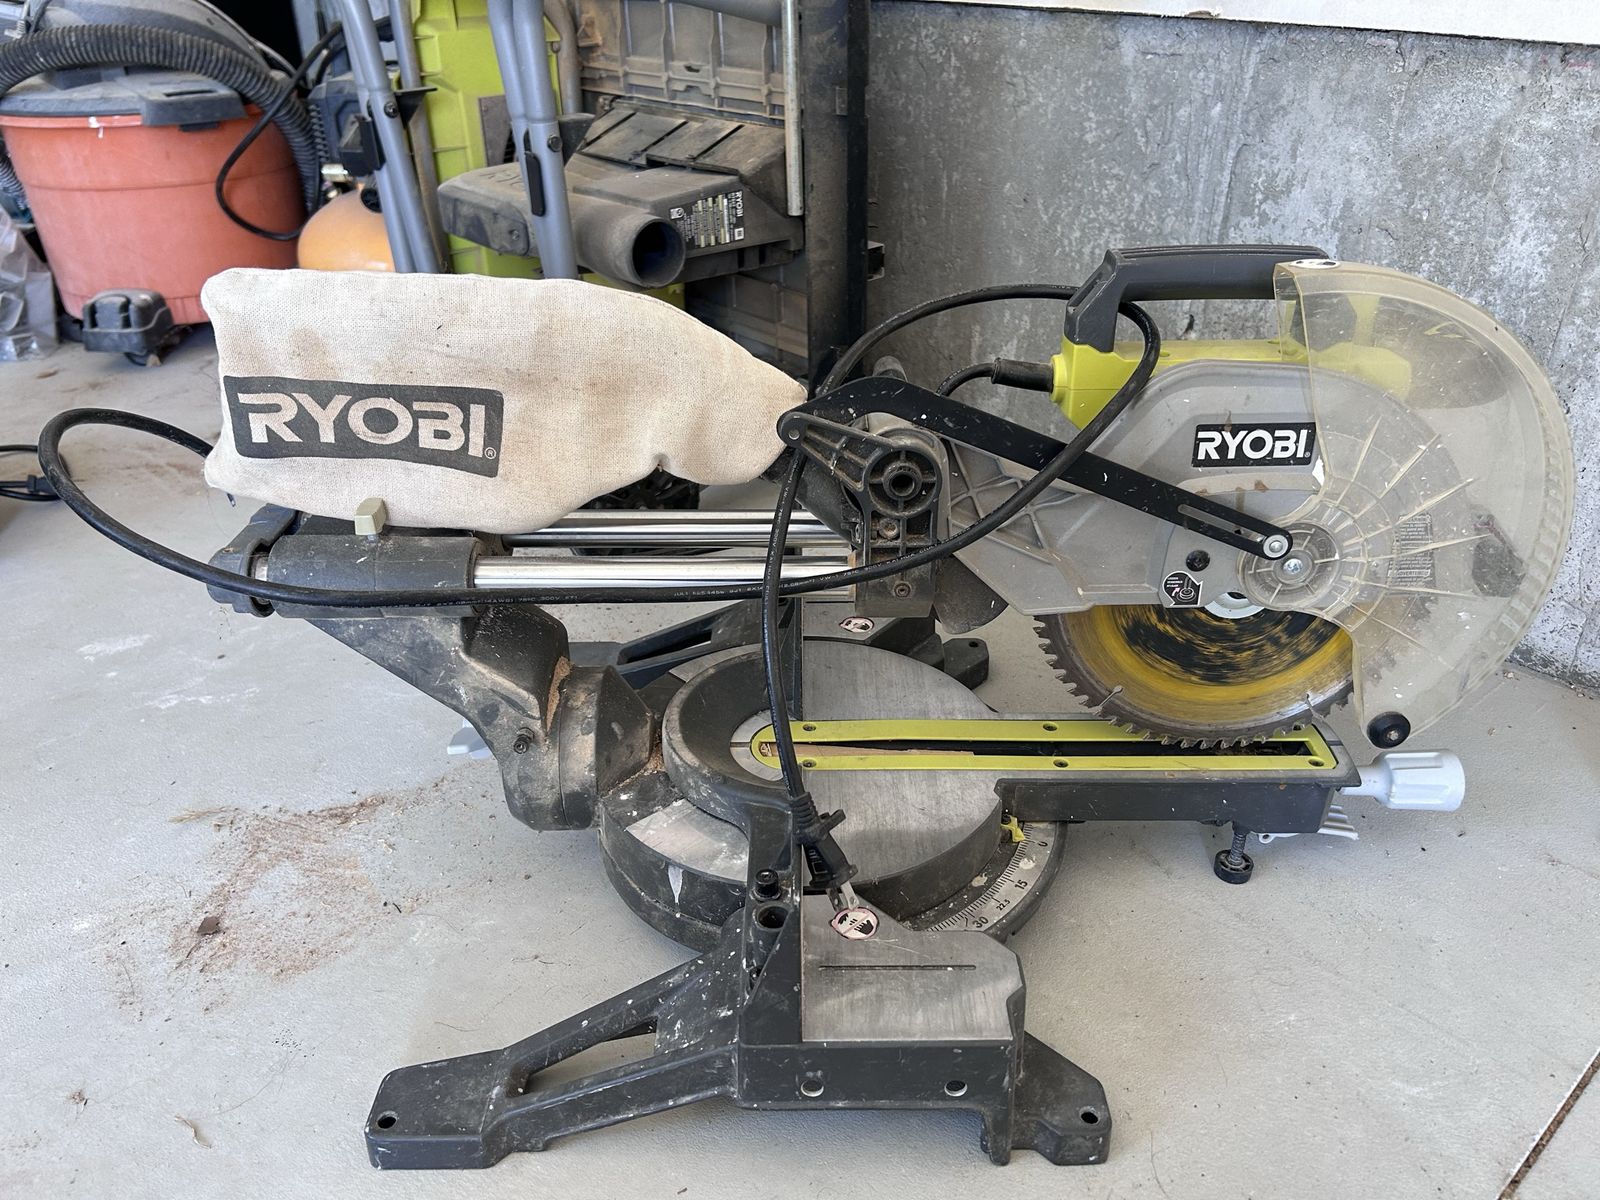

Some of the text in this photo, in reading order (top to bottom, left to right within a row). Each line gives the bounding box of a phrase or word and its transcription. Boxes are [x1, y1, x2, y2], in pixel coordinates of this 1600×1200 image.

[735, 190, 744, 217] RYOBI
[237, 392, 486, 458] RYOBI
[1197, 429, 1308, 460] RYOBI
[1014, 879, 1028, 890] 15
[996, 899, 1010, 911] 22.5
[972, 916, 989, 929] 30
